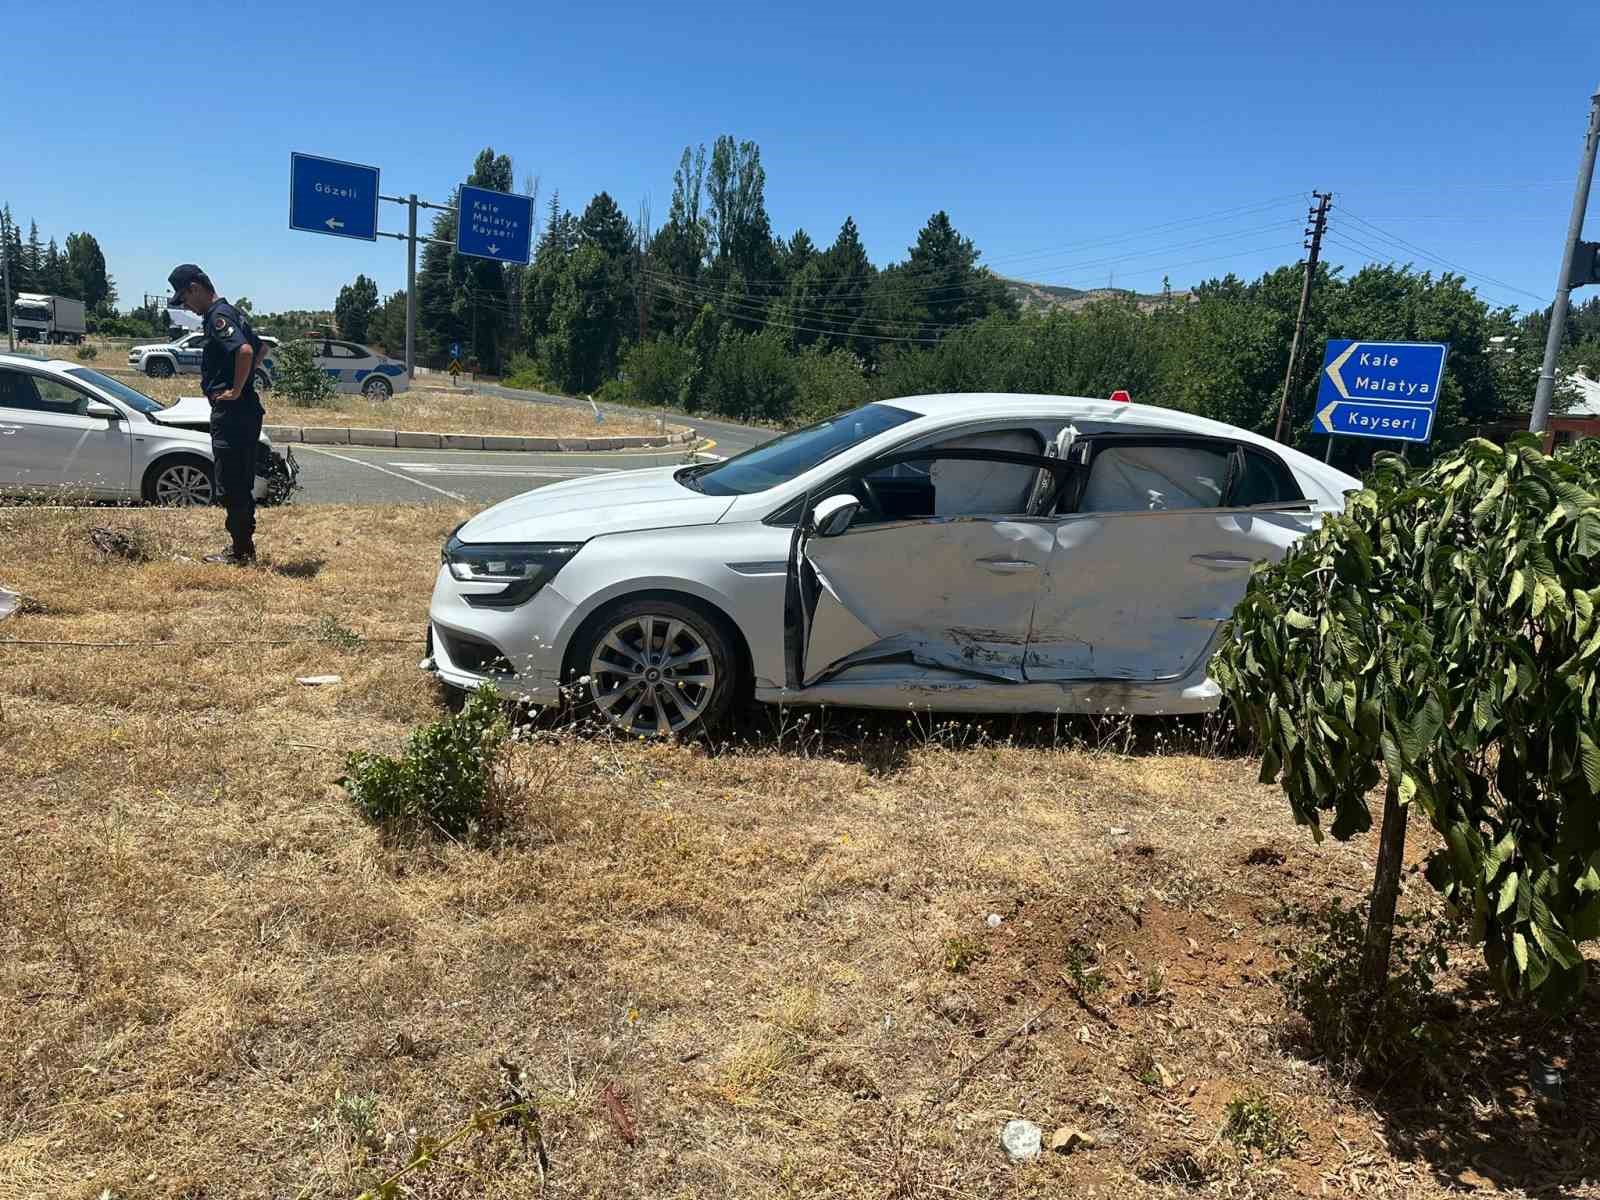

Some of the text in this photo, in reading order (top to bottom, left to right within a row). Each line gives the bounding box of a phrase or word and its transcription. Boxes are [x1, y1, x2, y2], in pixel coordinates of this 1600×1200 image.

[314, 182, 358, 199] Gözeli
[473, 200, 500, 212] Kale
[472, 212, 519, 229] Malatya
[472, 224, 515, 239] Kayseri
[1359, 352, 1399, 367] Kale
[1355, 376, 1430, 396] Malatya
[1348, 411, 1416, 430] Kayseri
